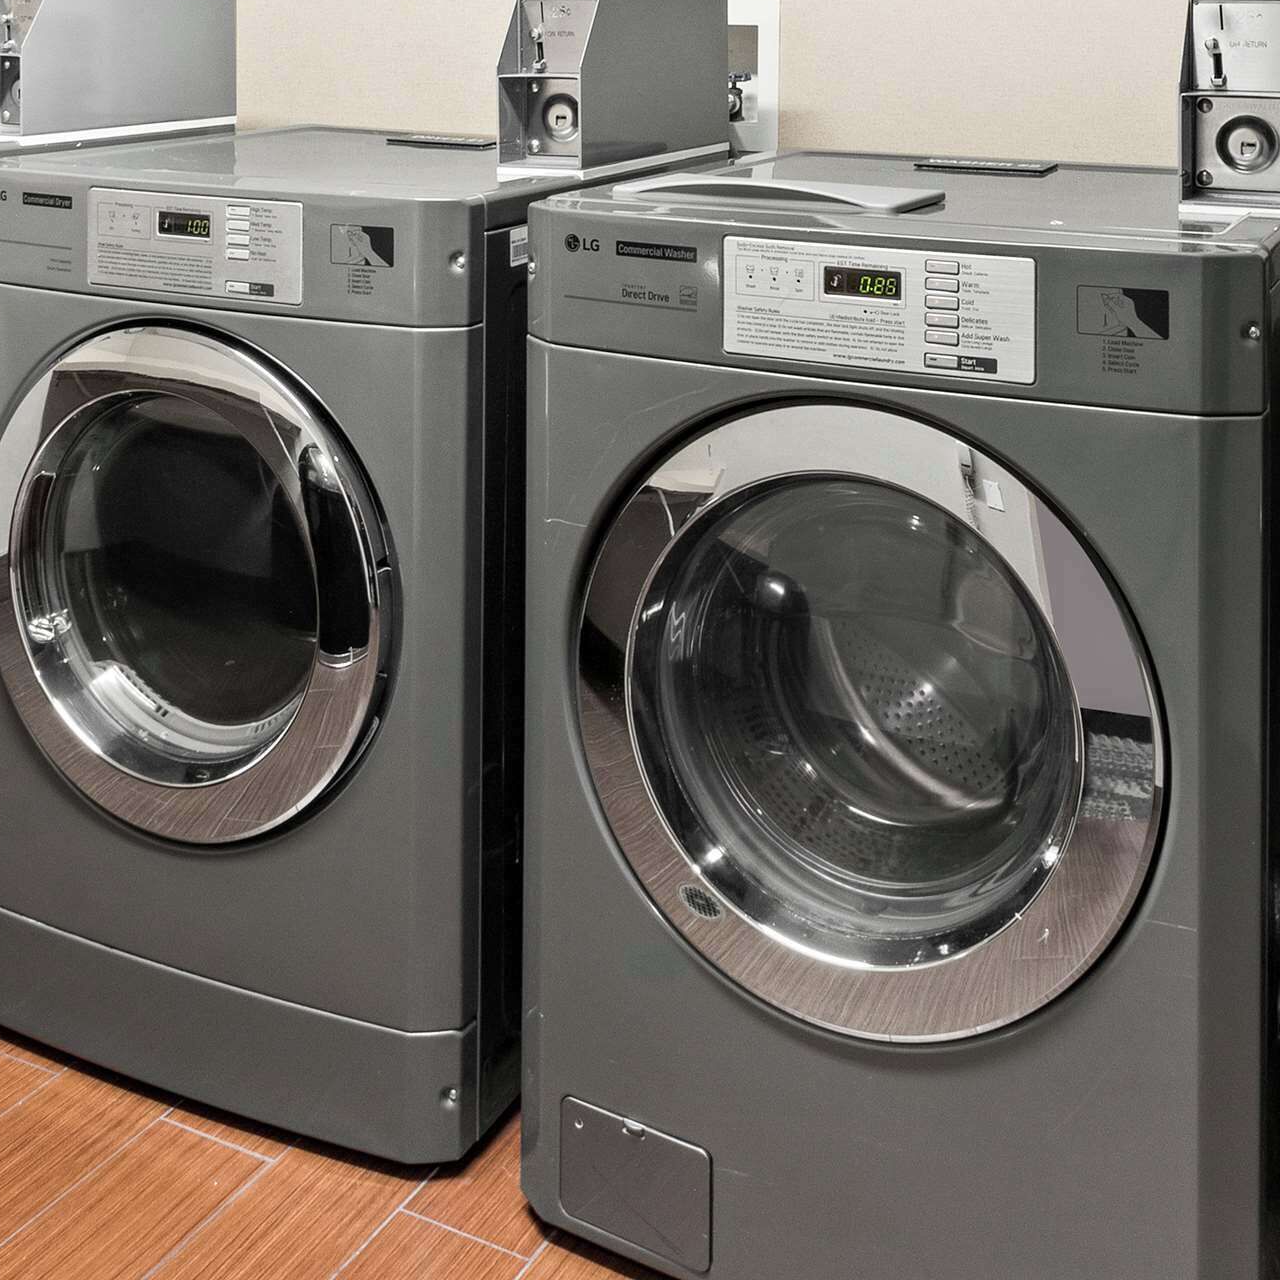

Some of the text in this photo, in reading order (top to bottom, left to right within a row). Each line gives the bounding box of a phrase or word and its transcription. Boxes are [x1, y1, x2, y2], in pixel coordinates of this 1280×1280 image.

[582, 238, 600, 252] LG
[618, 243, 695, 259] Commercial Washer
[621, 288, 670, 303] Direct Drive
